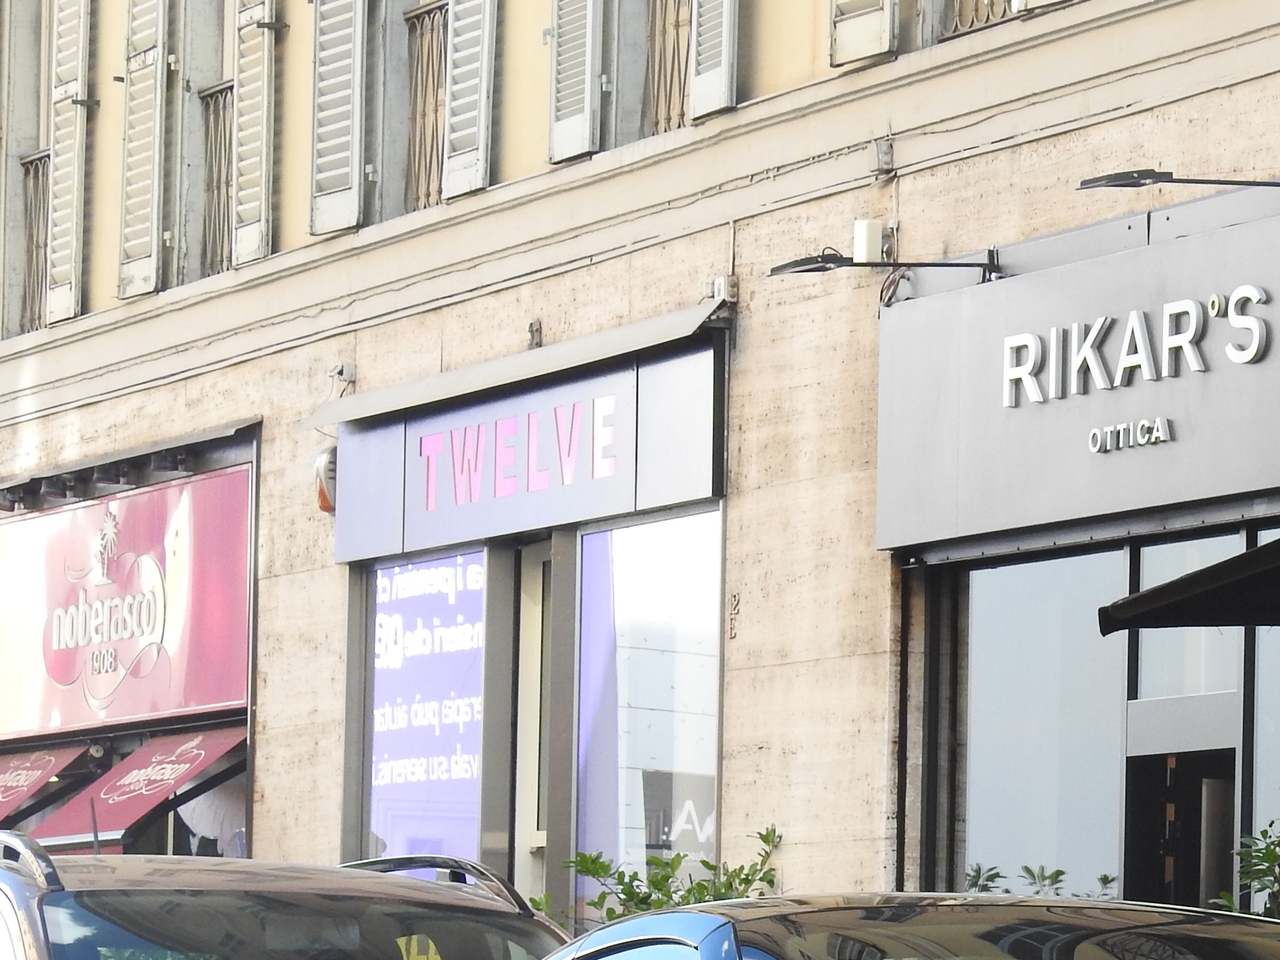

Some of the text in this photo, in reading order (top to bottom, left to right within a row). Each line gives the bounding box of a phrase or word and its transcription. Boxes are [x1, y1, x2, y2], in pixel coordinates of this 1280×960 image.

[420, 394, 619, 512] TWELVE
[1088, 417, 1174, 454] OTTICA
[52, 587, 156, 651] noberasco
